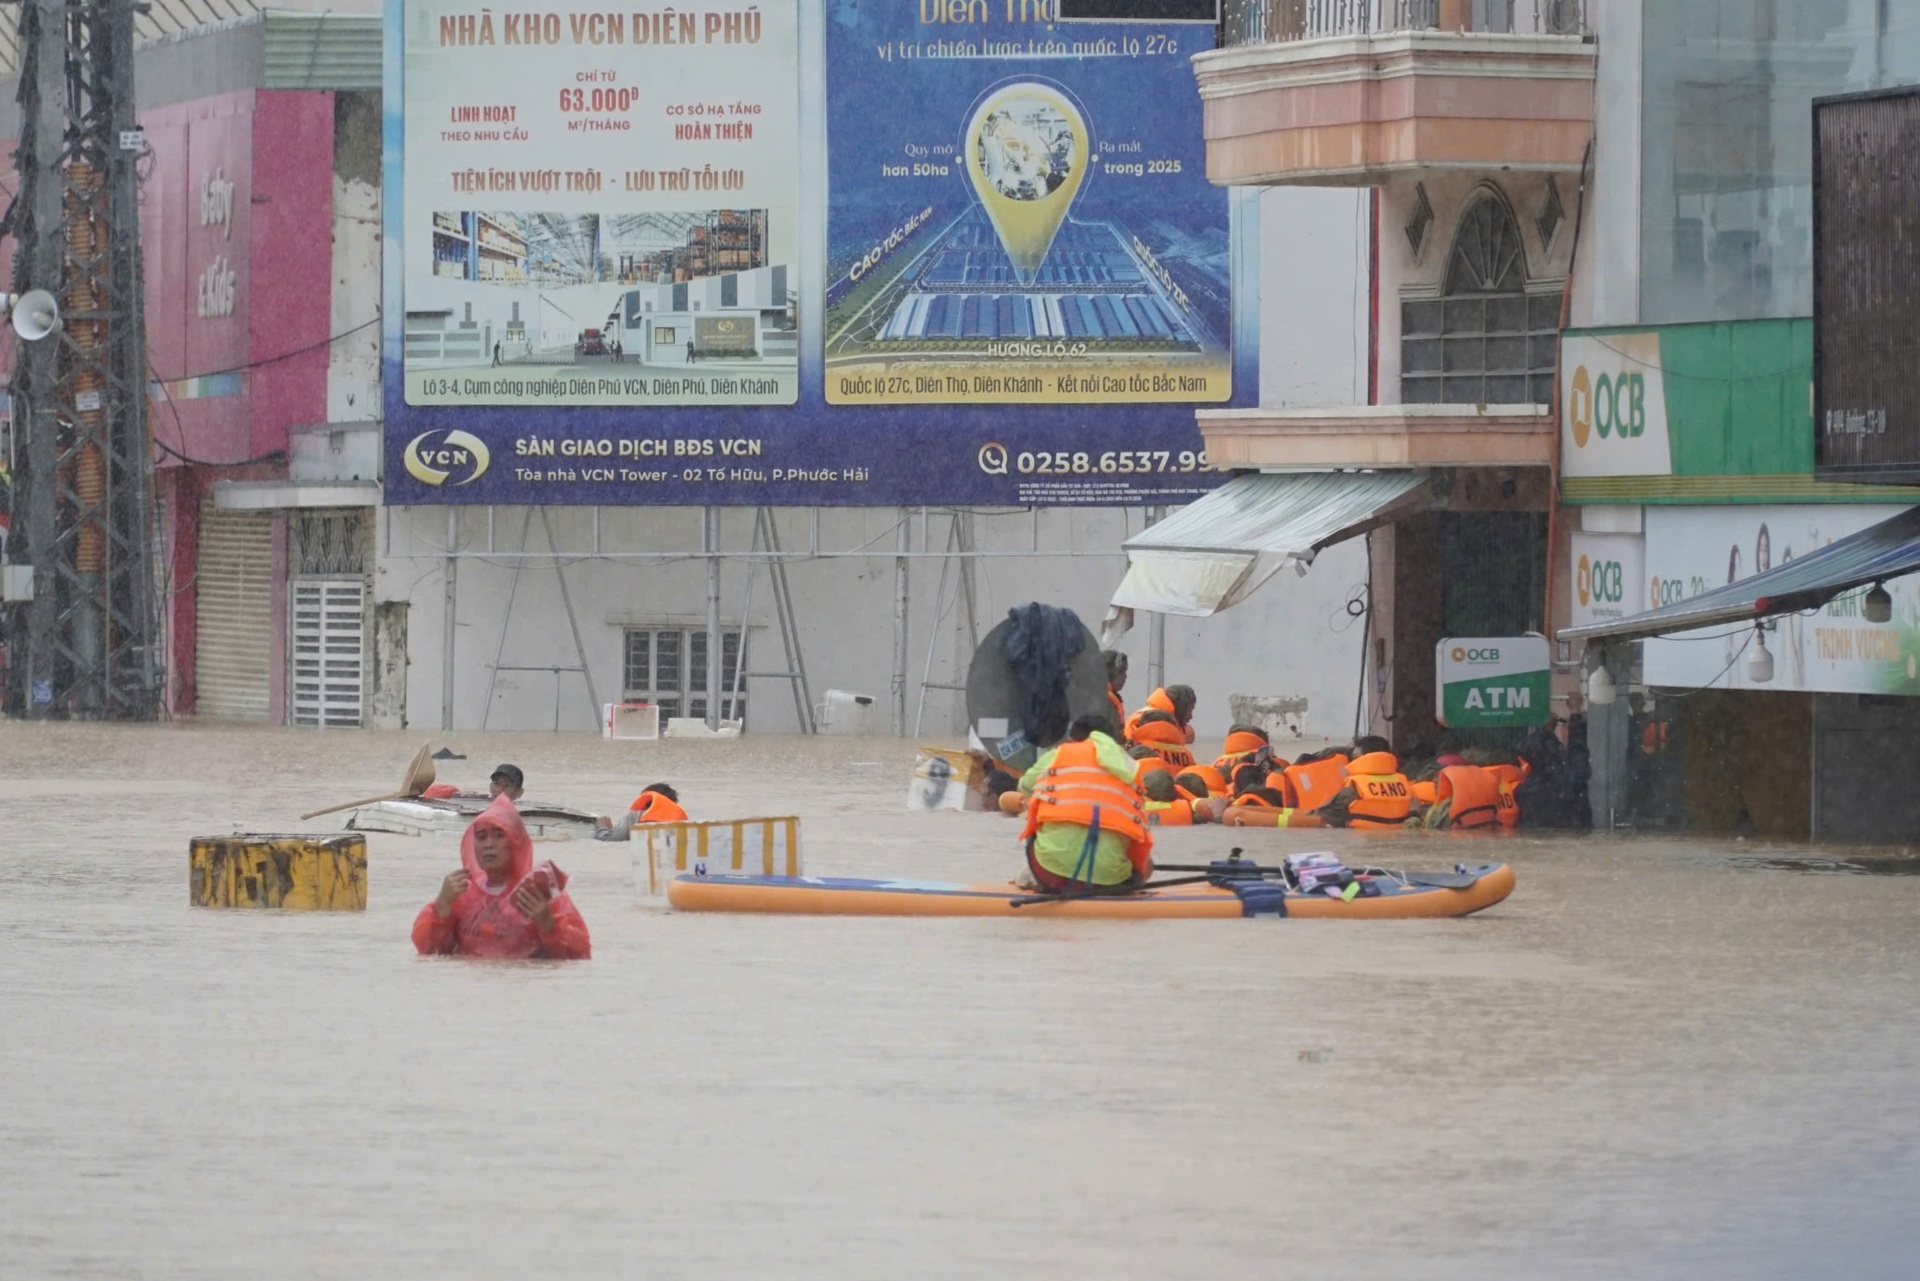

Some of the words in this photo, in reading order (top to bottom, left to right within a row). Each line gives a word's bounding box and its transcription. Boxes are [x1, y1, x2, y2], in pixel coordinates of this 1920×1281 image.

[440, 8, 496, 46] NHÀ
[504, 13, 561, 45] KHO
[569, 13, 623, 45] VCN
[633, 6, 696, 45] DIÊN
[704, 5, 761, 44] PHÚ
[877, 42, 892, 62] vị
[899, 41, 921, 58] trí
[927, 38, 977, 58] chiến
[1073, 37, 1117, 61] quốc
[1123, 36, 1140, 58] lộ
[1145, 35, 1178, 54] 27c
[451, 106, 480, 123] LINH
[483, 105, 517, 125] HOẠT
[666, 104, 685, 116] CƠ
[708, 104, 725, 118] HẠ
[441, 131, 471, 141] THEO
[474, 131, 500, 141] NHU
[675, 122, 711, 140] HOÀN
[715, 121, 752, 142] THIỆN
[905, 143, 930, 158] Quy
[933, 143, 953, 154] mô
[1099, 141, 1115, 152] Ra
[882, 163, 909, 176] hơn
[913, 163, 949, 176] 50ha
[1104, 163, 1143, 177] trong
[1147, 160, 1182, 173] 2025
[451, 168, 486, 195] TIỆN
[488, 168, 516, 191] ÍCH
[519, 169, 562, 195] VƯỢT
[565, 168, 602, 195] TRỘI
[625, 168, 655, 191] LƯU
[659, 167, 691, 191] TRỮ
[693, 163, 719, 191] TỐI
[722, 168, 744, 190] ƯU
[850, 246, 881, 281] CAO
[883, 227, 903, 253] TỐC
[987, 342, 1042, 357] HƯƠNG
[1046, 340, 1066, 360] LỘ
[1070, 343, 1086, 357] 62
[423, 378, 436, 395] Lô
[464, 379, 491, 397] Cụm
[493, 379, 523, 396] công
[526, 378, 567, 398] nghiệp
[569, 378, 595, 395] Diên
[599, 379, 621, 395] Phú
[624, 379, 650, 396] VCN,
[653, 378, 680, 395] Diên
[682, 378, 708, 396] Phú,
[711, 378, 738, 395] Diên
[740, 378, 778, 395] Khánh
[840, 375, 872, 395] Quốc
[874, 377, 886, 396] lộ
[888, 377, 913, 395] 27c,
[916, 376, 943, 393] Diên
[974, 376, 1000, 393] Diên
[1004, 375, 1043, 393] Khánh
[1057, 374, 1078, 393] Kết
[1080, 374, 1100, 392] nối
[1103, 376, 1126, 392] Cao
[1129, 373, 1150, 392] tốc
[1152, 373, 1176, 392] Bắc
[1179, 375, 1207, 391] Nam
[1594, 372, 1645, 439] OCB
[420, 450, 468, 465] VCN
[515, 435, 555, 456] SÀN
[561, 438, 613, 456] GIAO
[619, 438, 668, 460] DỊCH
[674, 438, 714, 456] BĐS
[719, 438, 761, 456] VCN
[515, 467, 542, 481] Tòa
[547, 467, 576, 481] nhà
[581, 468, 614, 481] VCN
[619, 468, 668, 481] Tower
[683, 468, 702, 481] 02
[706, 467, 726, 481] Tố
[730, 467, 767, 483] Hữu,
[772, 467, 838, 481] P.Phước
[843, 467, 869, 481] Hải
[1592, 560, 1623, 602] OCB
[1467, 648, 1500, 660] OCB
[1463, 687, 1531, 709] ATM
[1368, 781, 1407, 798] CAND
